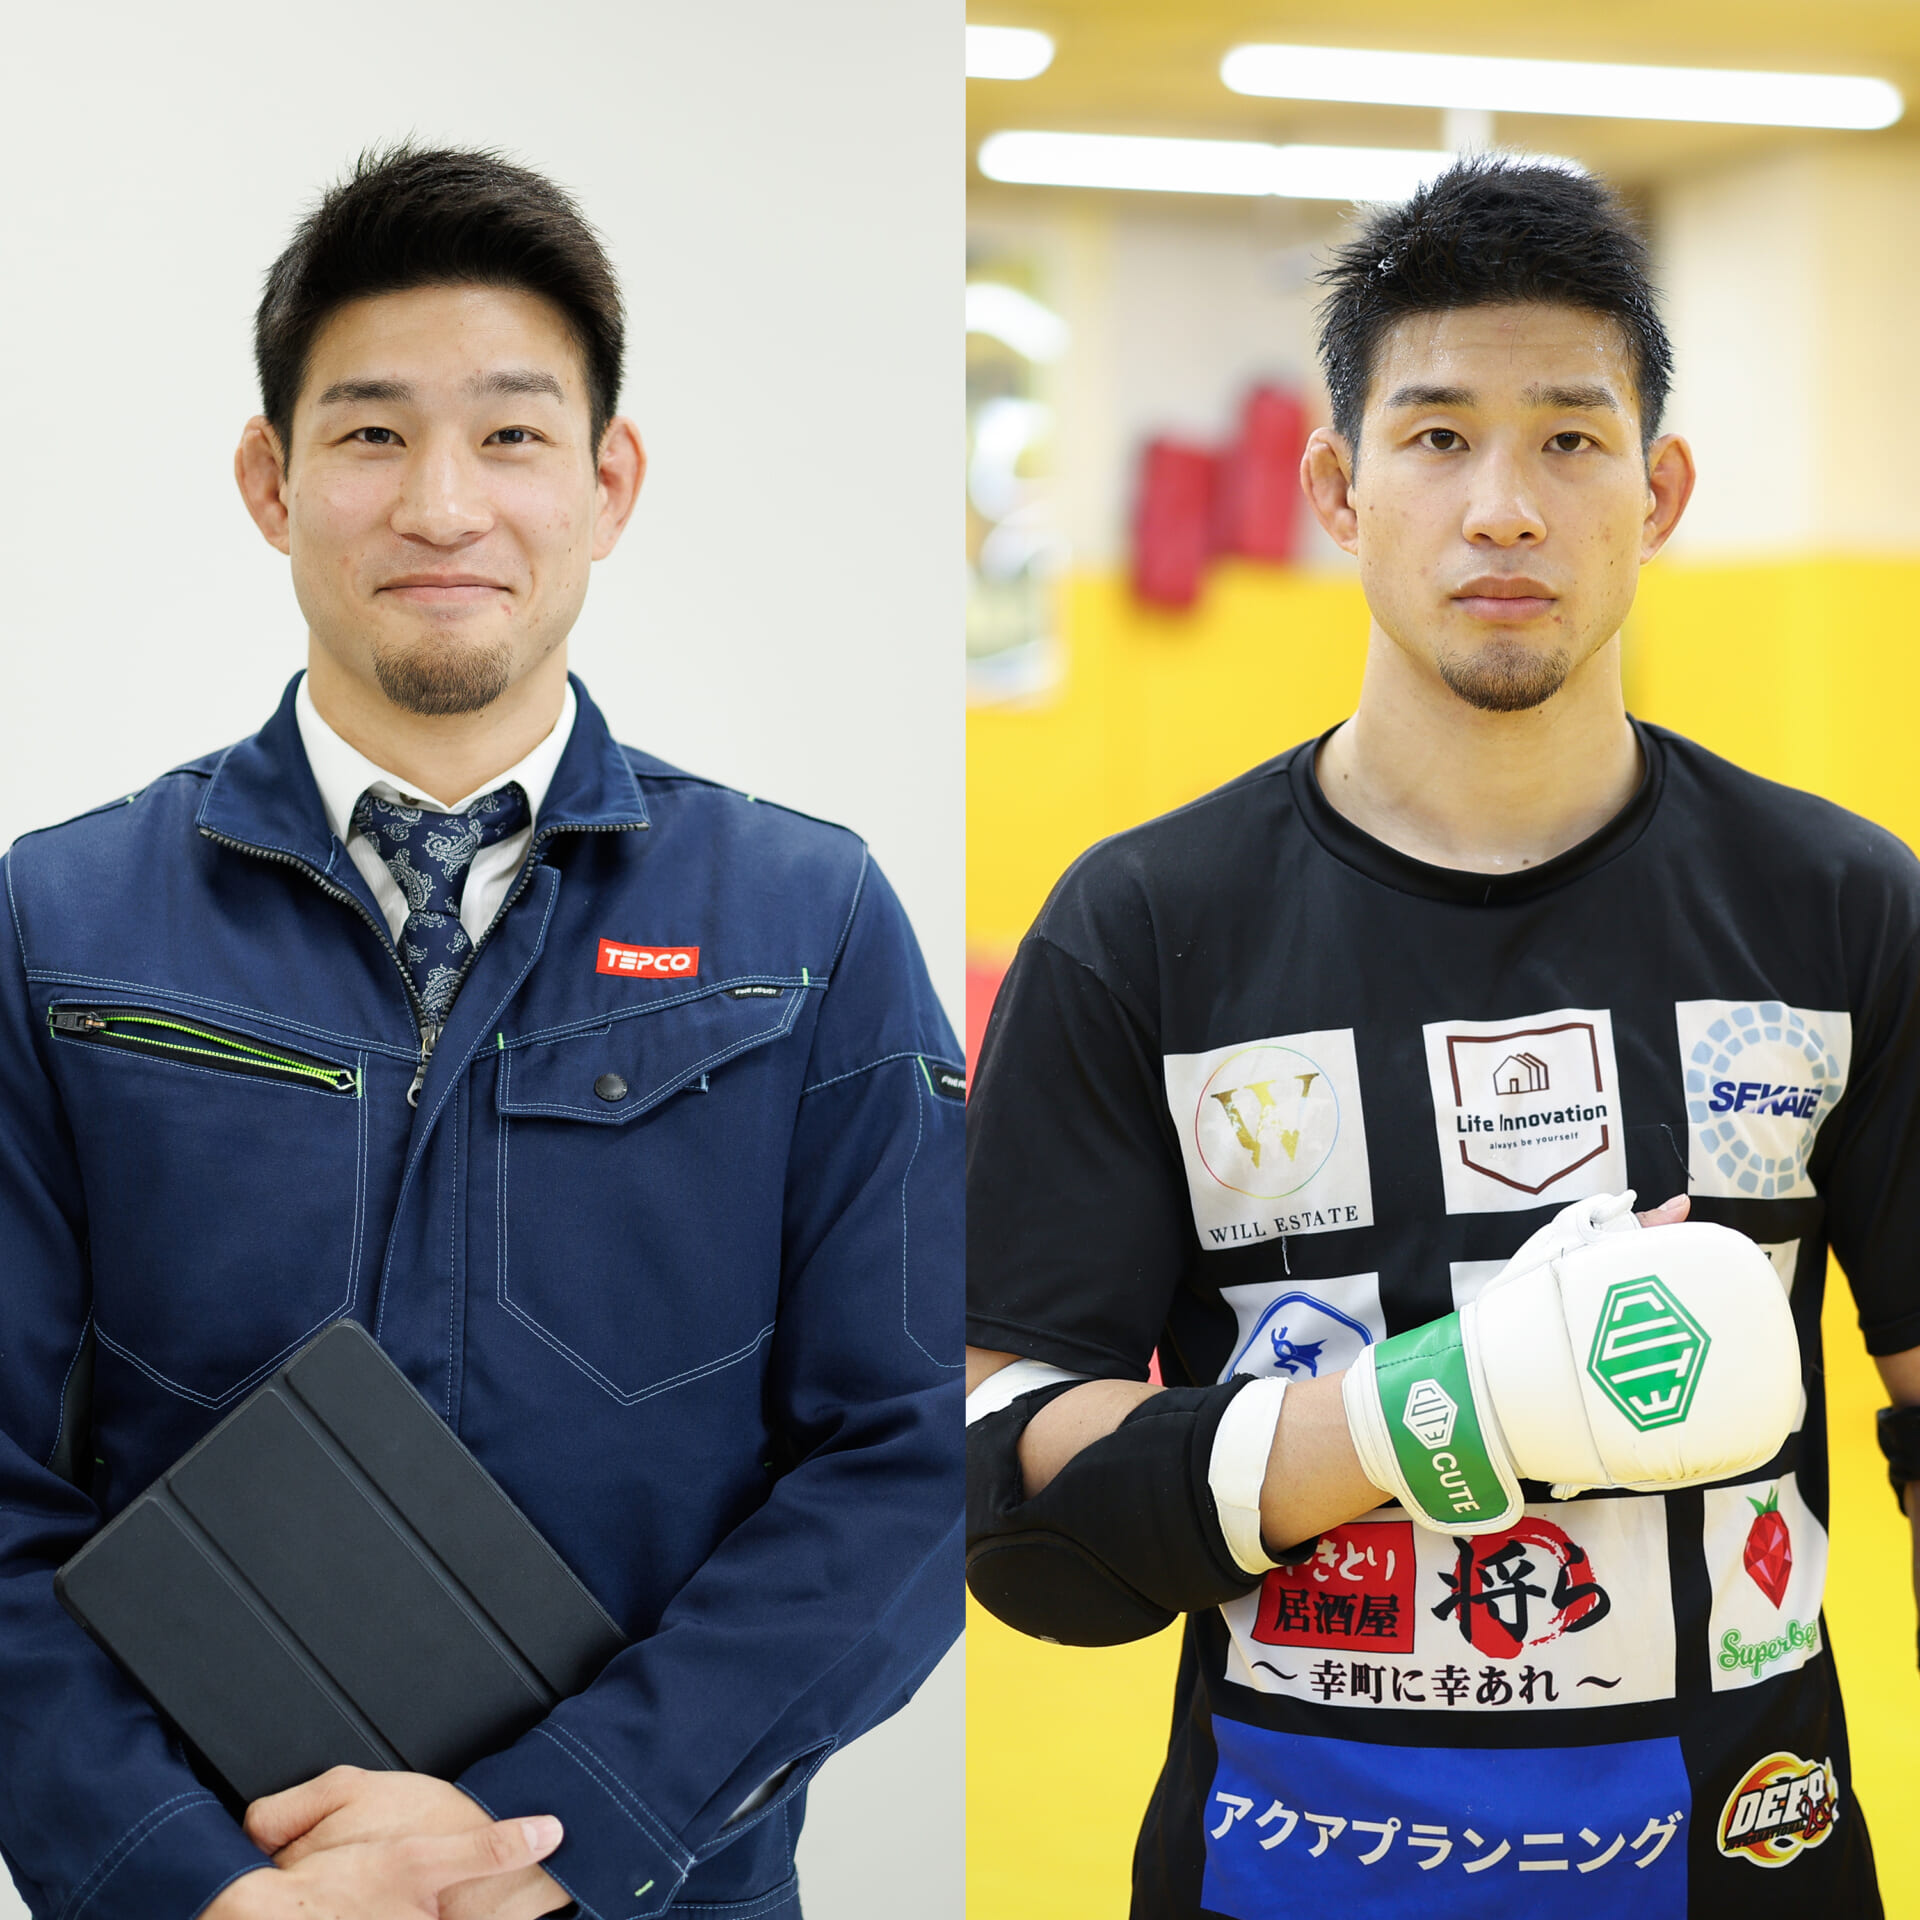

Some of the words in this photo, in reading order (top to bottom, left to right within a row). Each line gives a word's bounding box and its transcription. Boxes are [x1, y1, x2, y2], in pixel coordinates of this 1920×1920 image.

[605, 948, 691, 971] TEPCO
[1457, 1115, 1495, 1133] Life
[1500, 1104, 1608, 1131] Innovation
[1490, 1140, 1518, 1150] always
[1521, 1136, 1533, 1147] be
[1536, 1132, 1579, 1145] yourself
[1209, 1221, 1266, 1243] WILL
[1274, 1205, 1359, 1233] ESTATE
[1432, 1452, 1481, 1514] CUTE
[1287, 1539, 1396, 1583] きとり
[1274, 1586, 1401, 1638] 居酒屋
[1210, 1791, 1683, 1874] アクアプランニング
